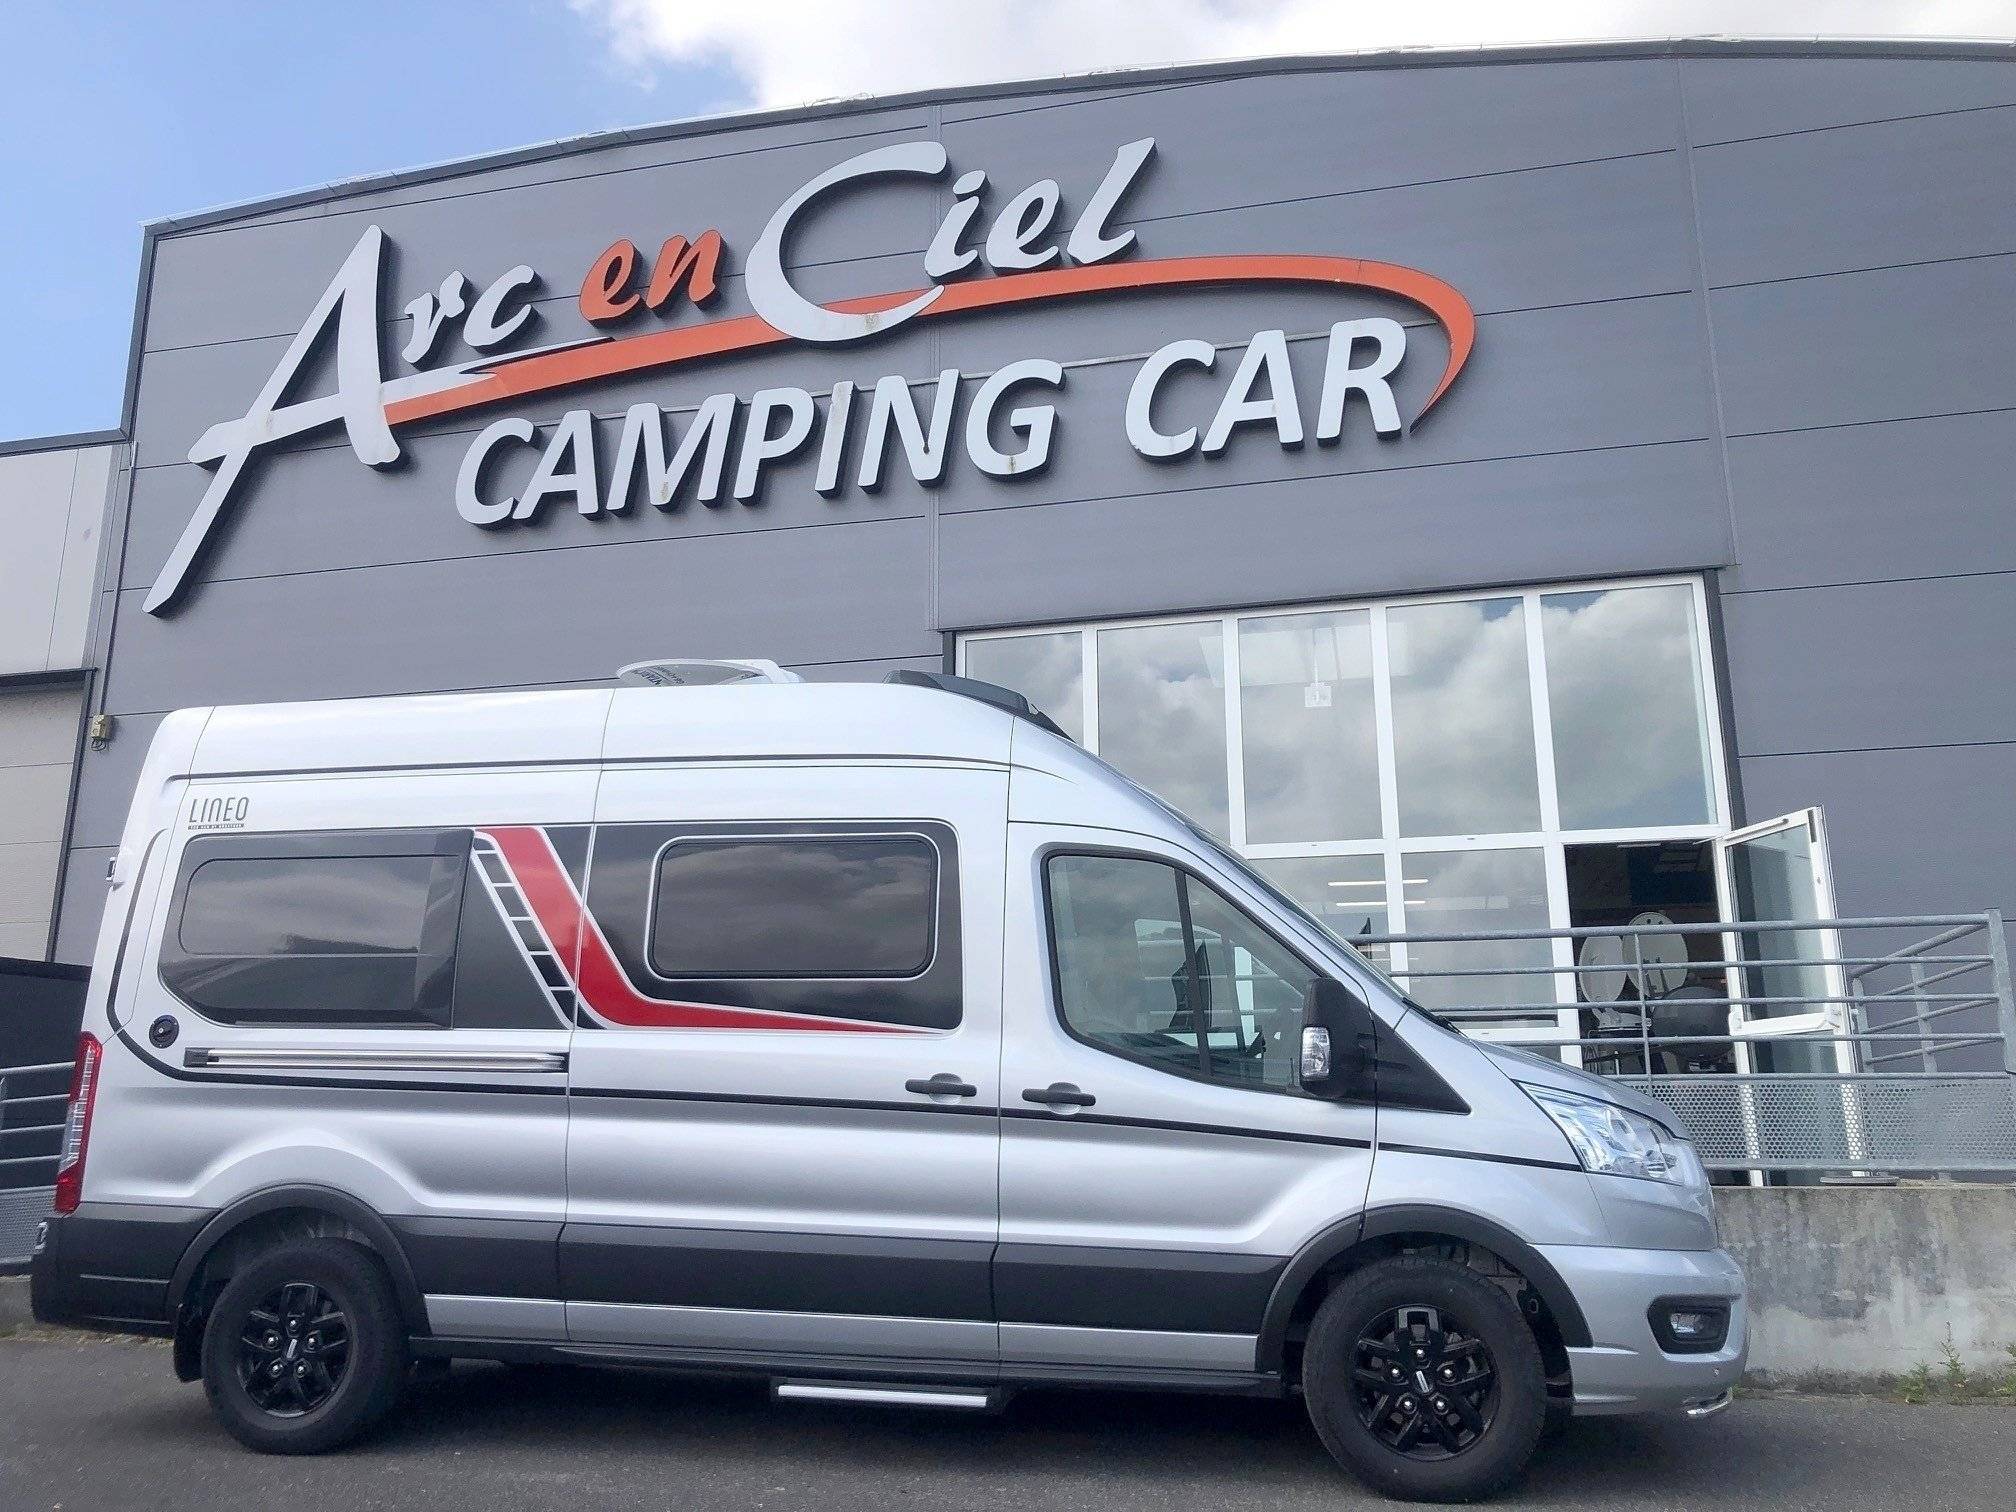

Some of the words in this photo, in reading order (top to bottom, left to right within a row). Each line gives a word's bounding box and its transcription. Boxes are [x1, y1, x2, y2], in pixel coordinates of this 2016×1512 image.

[142, 224, 536, 614] Arc
[579, 229, 722, 321] en
[745, 137, 1157, 341] Ciel
[455, 359, 1063, 524] CAMPING
[1124, 317, 1406, 460] CAR
[189, 797, 249, 822] LINEO
